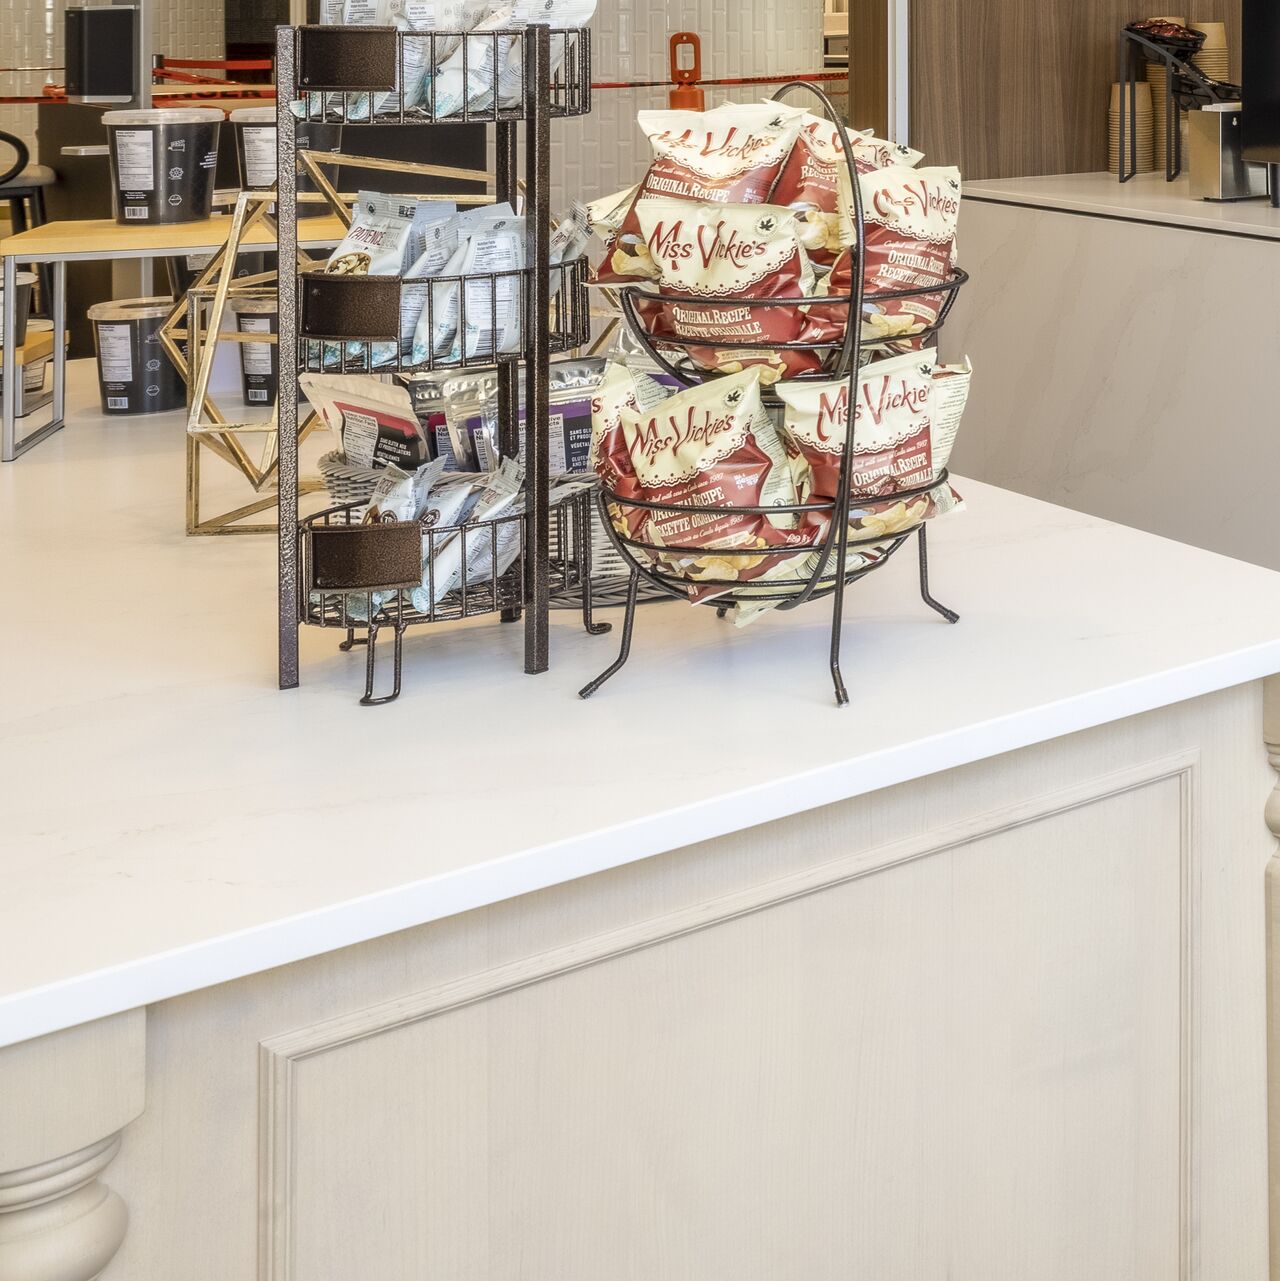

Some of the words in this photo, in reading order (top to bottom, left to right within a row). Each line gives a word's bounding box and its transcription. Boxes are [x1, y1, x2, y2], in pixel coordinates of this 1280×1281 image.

[649, 219, 693, 271] Miss
[697, 220, 767, 270] Vickie's
[863, 374, 931, 425] Vickie'
[629, 417, 671, 467] Miss
[669, 406, 736, 457] Vickie's
